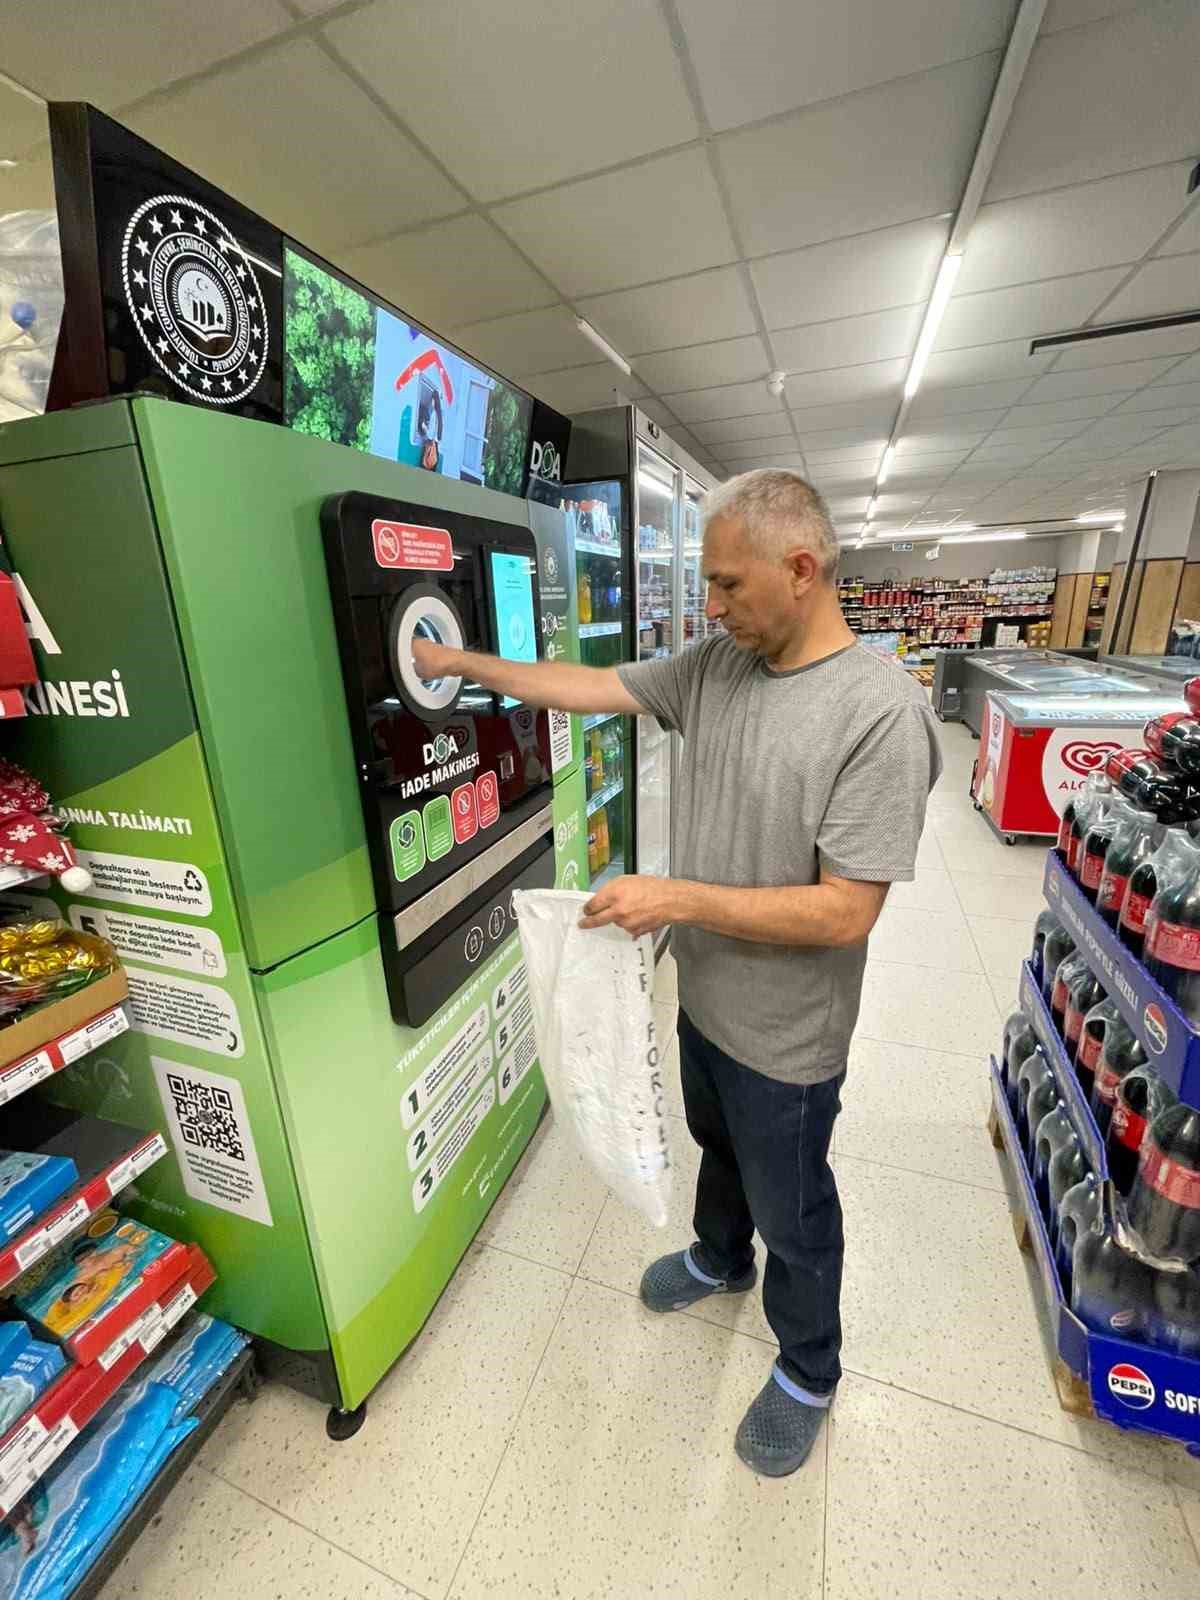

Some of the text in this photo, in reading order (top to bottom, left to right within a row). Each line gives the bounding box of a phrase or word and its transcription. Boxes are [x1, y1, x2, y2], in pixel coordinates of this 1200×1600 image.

[108, 809, 192, 835] TALİMATI
[500, 1026, 508, 1049] 5
[503, 1066, 511, 1089] 6
[408, 1089, 419, 1114] 1
[415, 1130, 428, 1159] 2
[420, 1168, 433, 1198] 3
[1111, 1377, 1152, 1396] PEPSI
[1164, 1390, 1200, 1415] SOF
